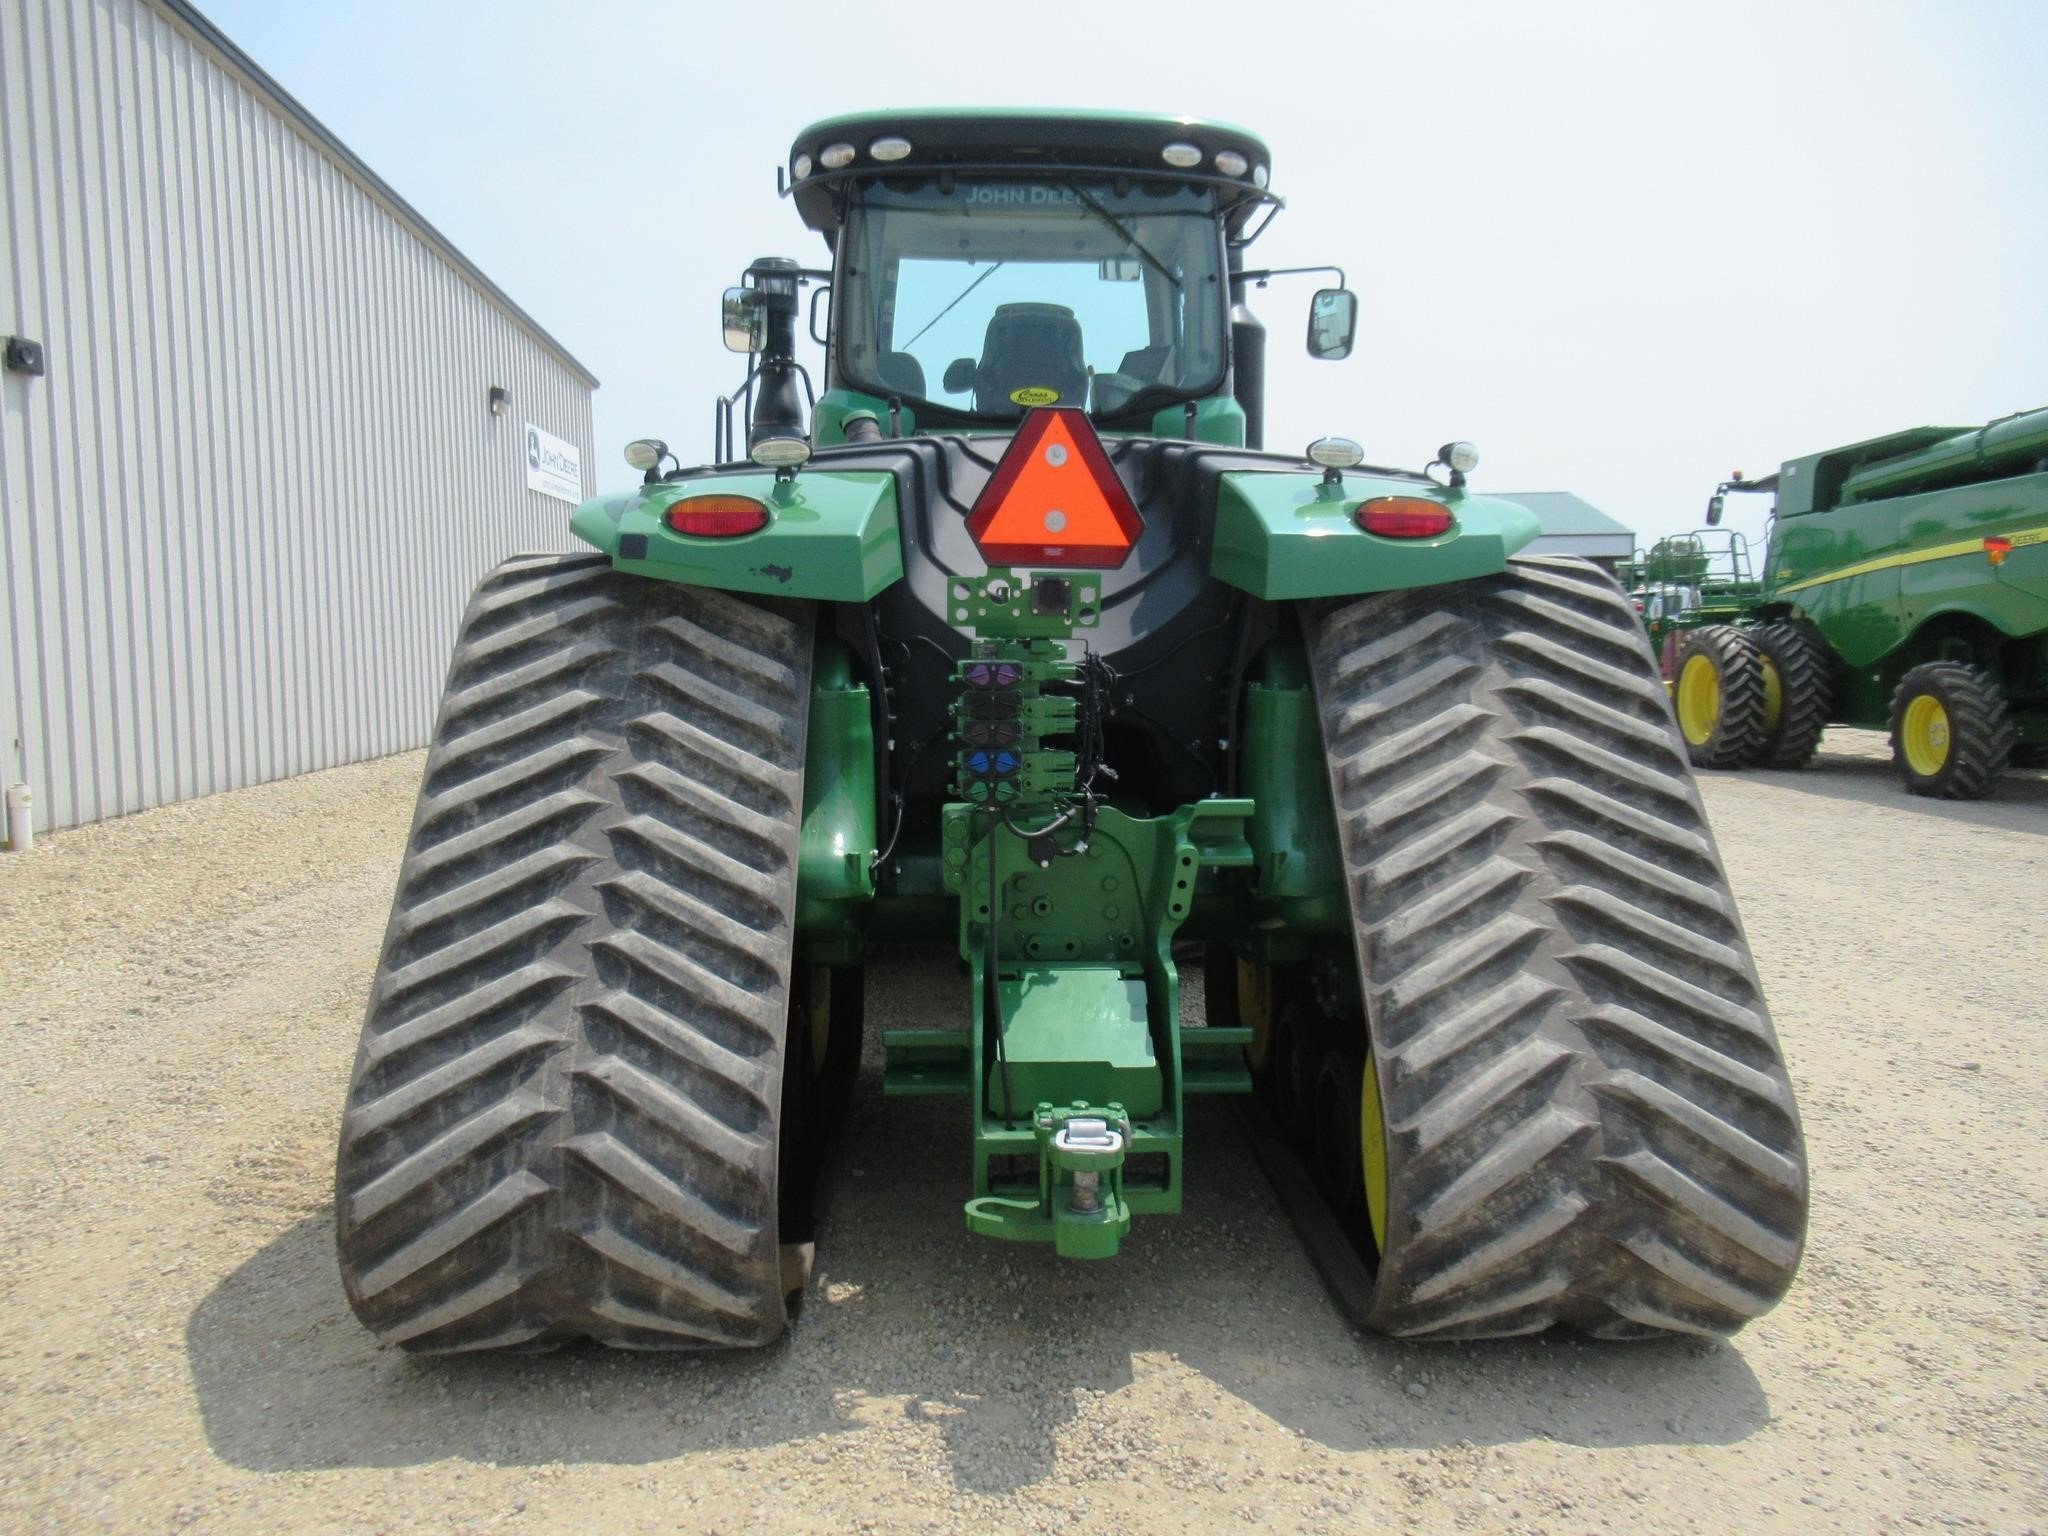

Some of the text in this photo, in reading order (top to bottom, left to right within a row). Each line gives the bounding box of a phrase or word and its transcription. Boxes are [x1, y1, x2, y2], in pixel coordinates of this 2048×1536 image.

[966, 187, 1025, 204] JOHN
[542, 446, 578, 478] JOHN DEERE
